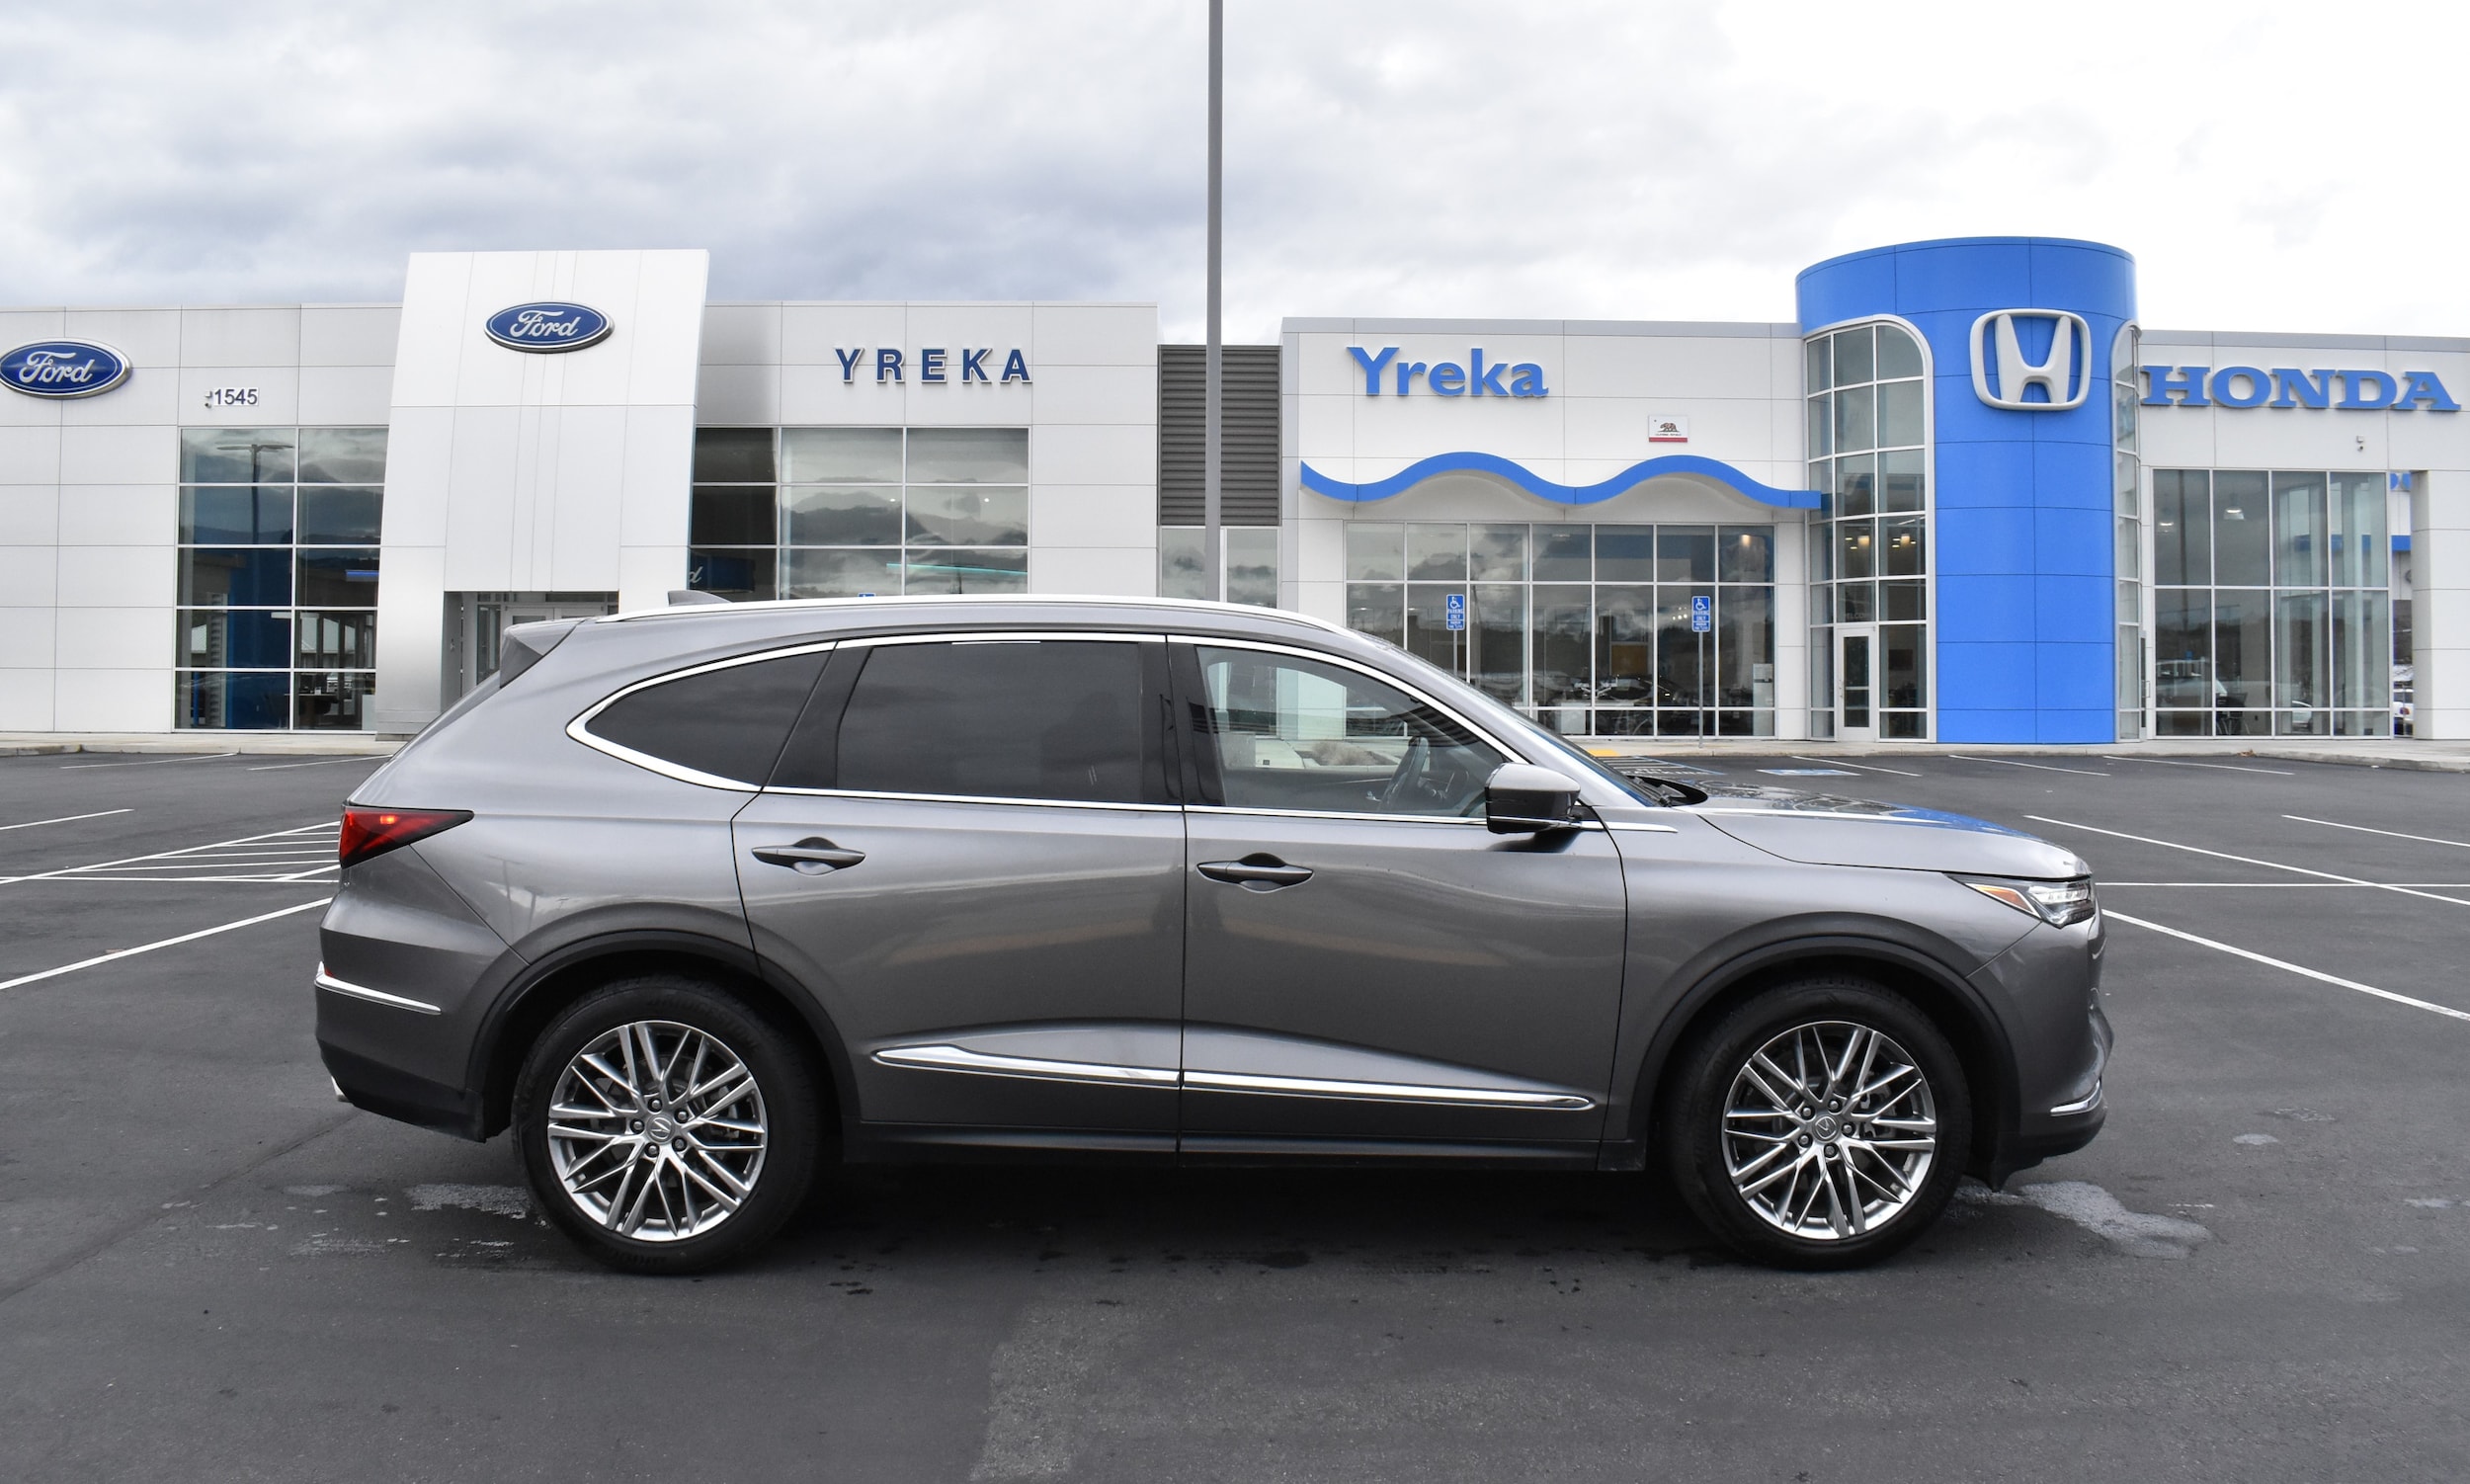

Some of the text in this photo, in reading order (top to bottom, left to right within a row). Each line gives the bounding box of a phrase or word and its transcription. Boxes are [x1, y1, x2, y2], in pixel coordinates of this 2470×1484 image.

[510, 309, 582, 337] Ford
[19, 351, 95, 383] Ford
[835, 348, 1032, 383] YREKA
[1347, 346, 1549, 397] Yreka
[214, 388, 258, 405] 1545
[2140, 365, 2462, 412] HONDA
